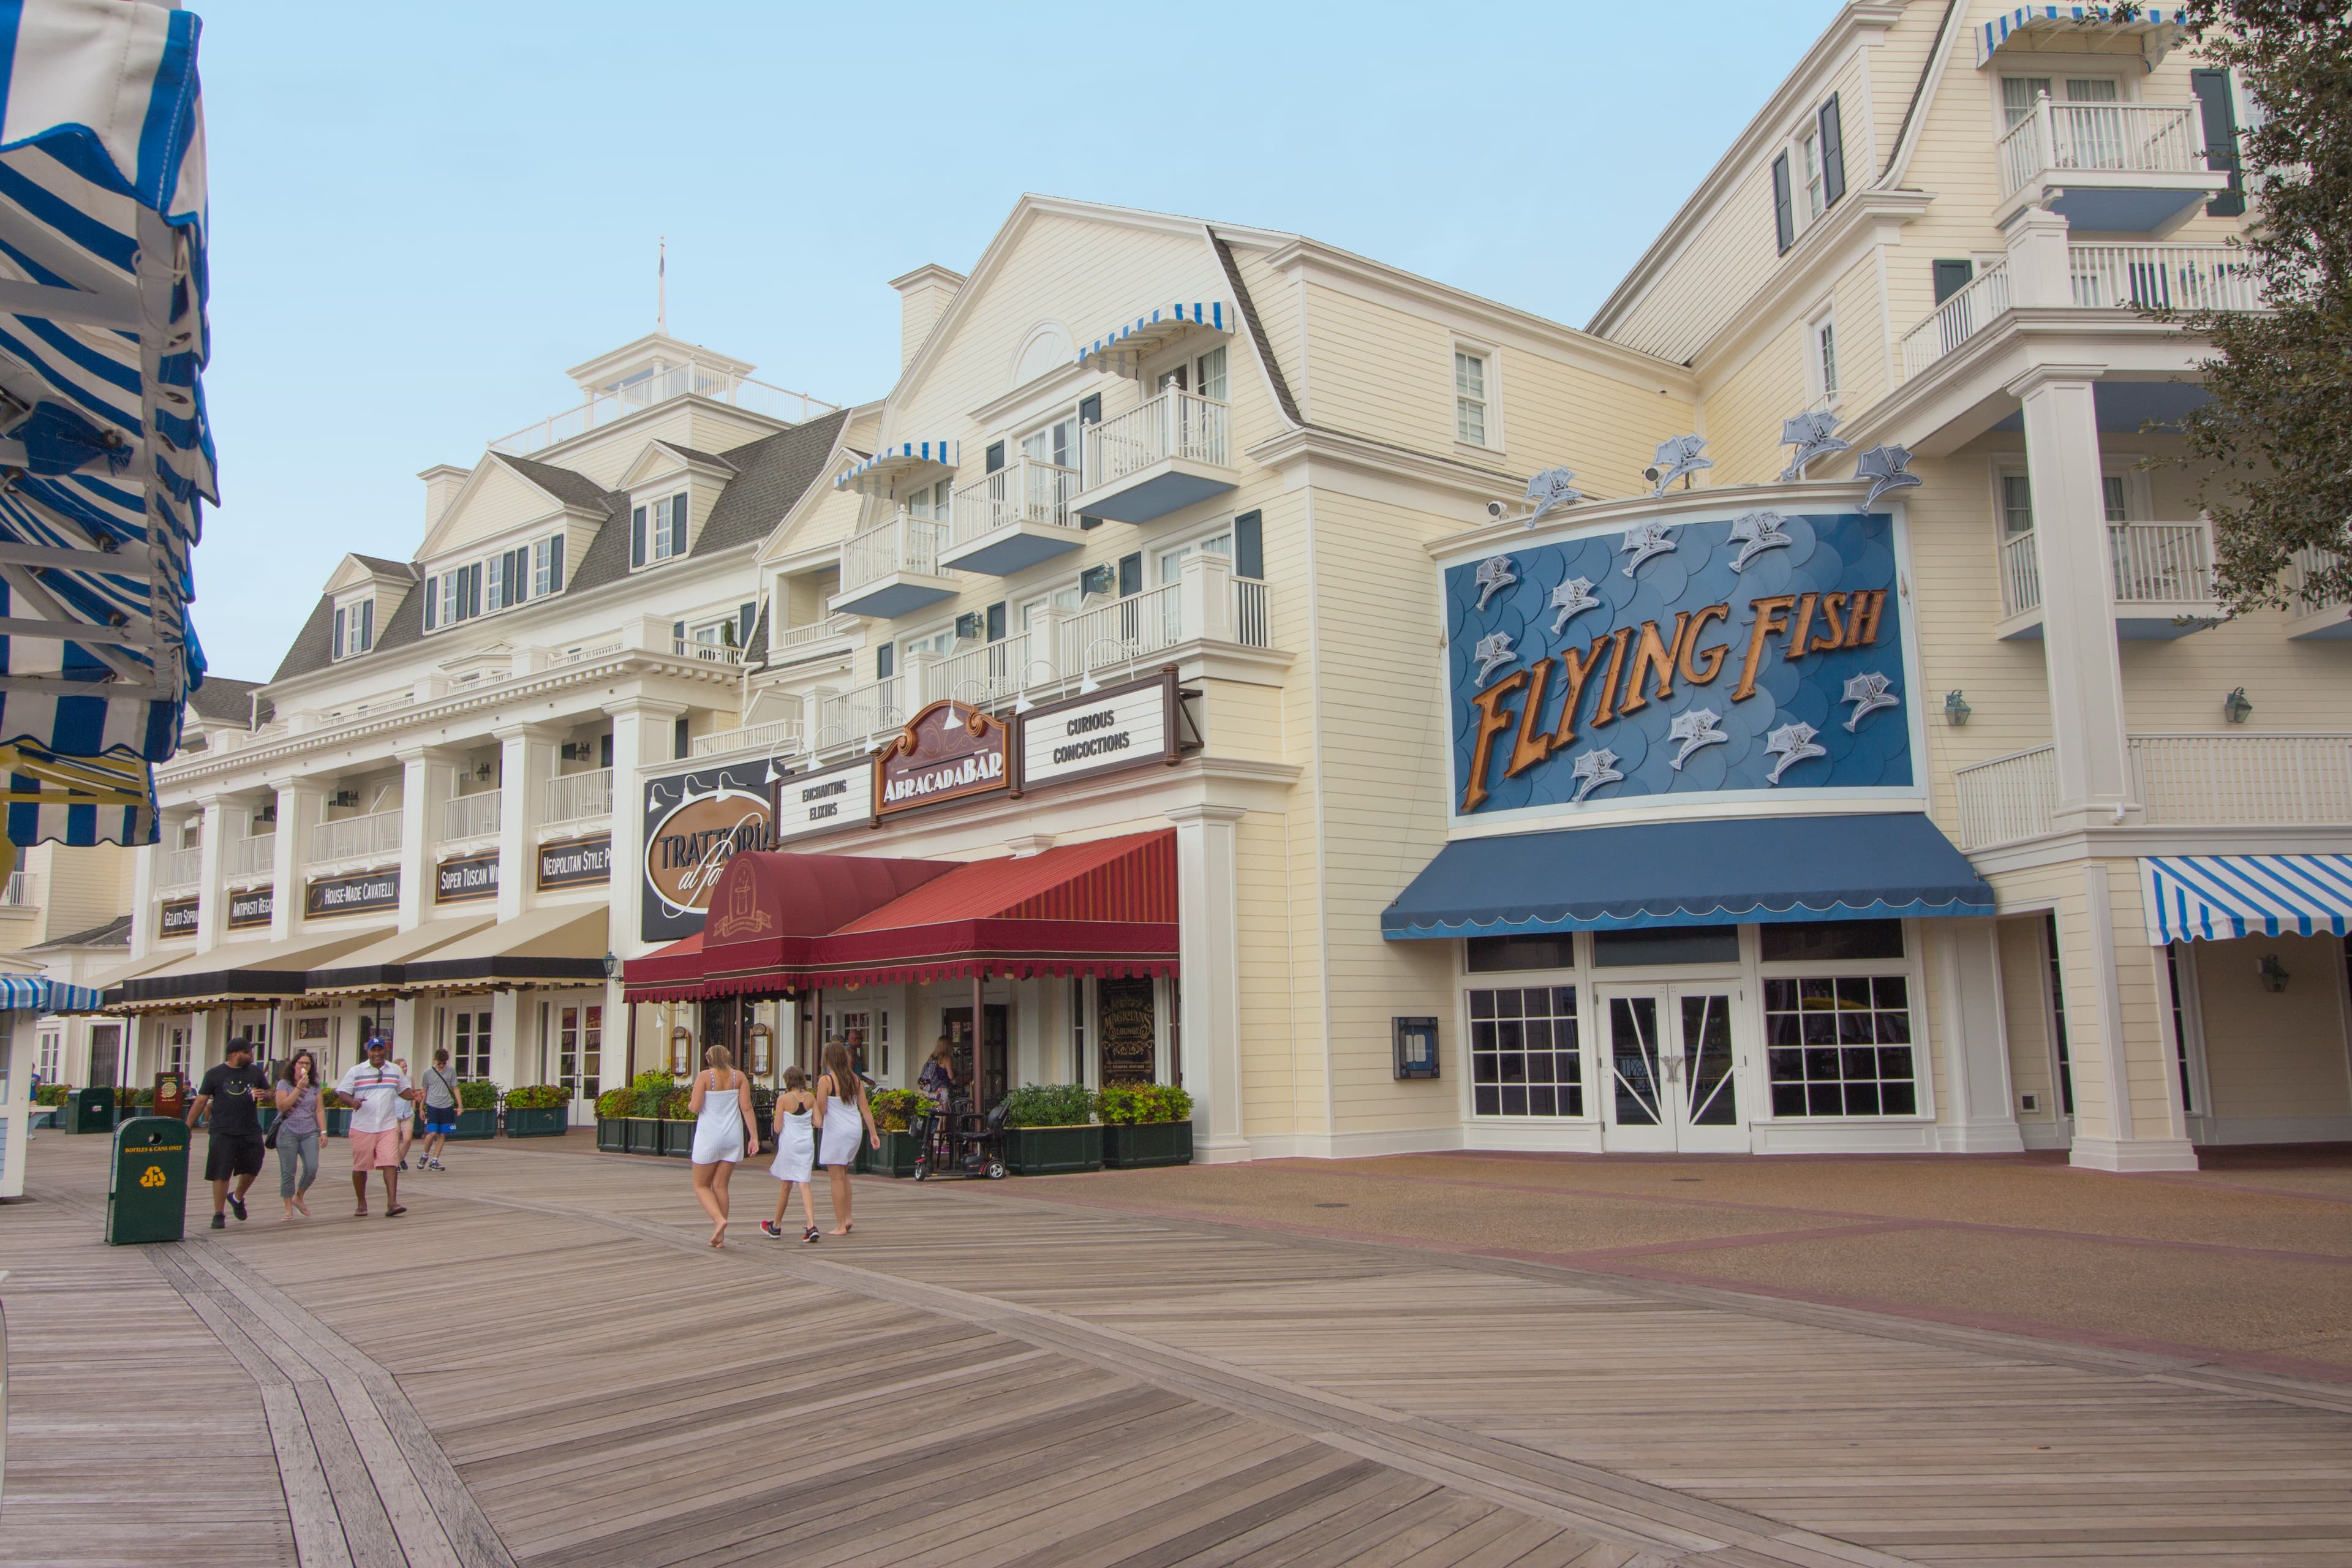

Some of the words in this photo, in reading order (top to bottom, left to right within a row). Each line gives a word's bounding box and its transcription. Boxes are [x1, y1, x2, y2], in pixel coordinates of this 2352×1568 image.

[1460, 601, 1730, 812] FLYING
[1731, 589, 1888, 703] FISH
[1066, 709, 1115, 736] CURIOUS
[1053, 731, 1130, 764] CONCOCTIONS
[802, 779, 847, 803] ENCHANTING
[809, 802, 838, 821] ELIXIRS
[543, 854, 582, 876] NEOPOLITAN
[582, 850, 603, 871] STYLE
[441, 871, 462, 890] SUPER
[463, 868, 488, 887] TUSCAN
[325, 885, 362, 905] HOUSE-MADE
[363, 882, 394, 900] CAVATELLI
[165, 911, 183, 927] GELATO
[233, 901, 258, 917] ANTIPASTI
